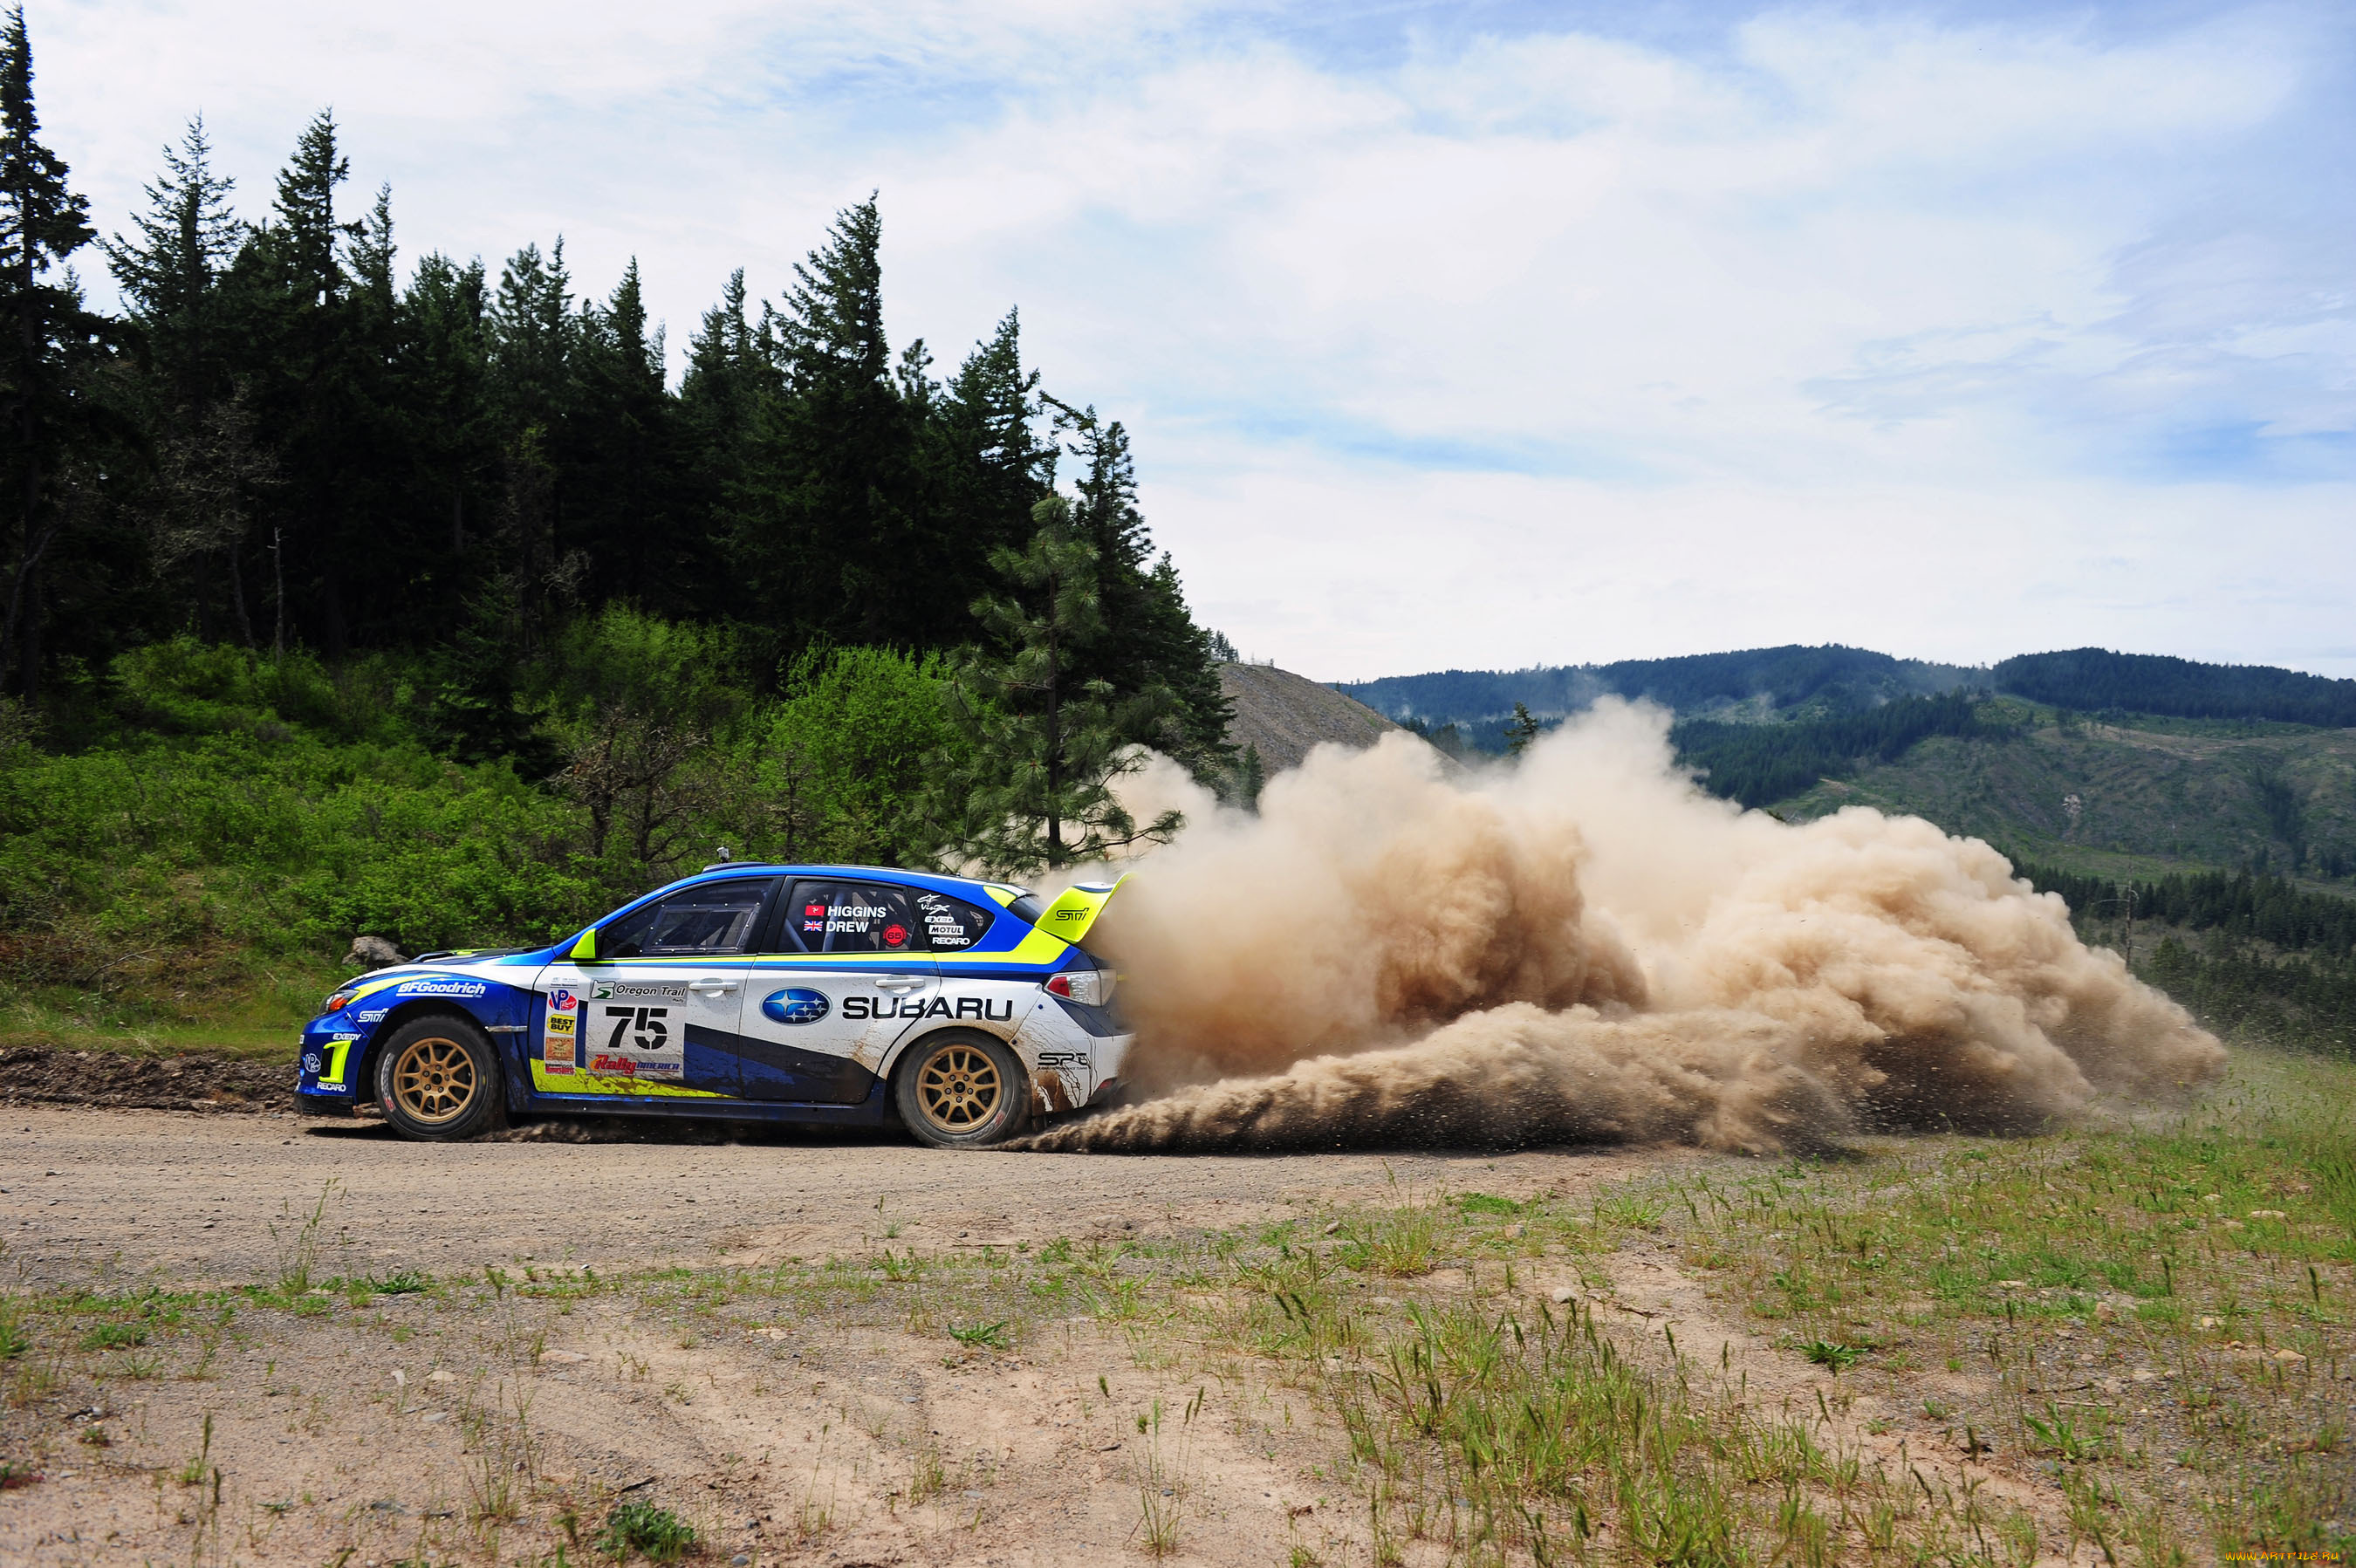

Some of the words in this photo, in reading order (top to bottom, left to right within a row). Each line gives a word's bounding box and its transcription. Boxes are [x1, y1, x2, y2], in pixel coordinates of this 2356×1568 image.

[827, 906, 887, 918] HIGGINS
[825, 921, 869, 933] DREW
[887, 931, 902, 940] 65
[397, 982, 486, 995] BFGoodrich
[616, 984, 657, 996] Oregon
[661, 986, 686, 996] Trail
[550, 989, 569, 1010] VP
[842, 996, 1013, 1022] SUBARU
[551, 1017, 575, 1025] BEST
[606, 1006, 668, 1051] 75
[332, 1032, 362, 1041] EXEDY
[593, 1054, 637, 1075] Rally
[636, 1062, 681, 1071] AMERICA
[317, 1082, 347, 1092] RECARO
